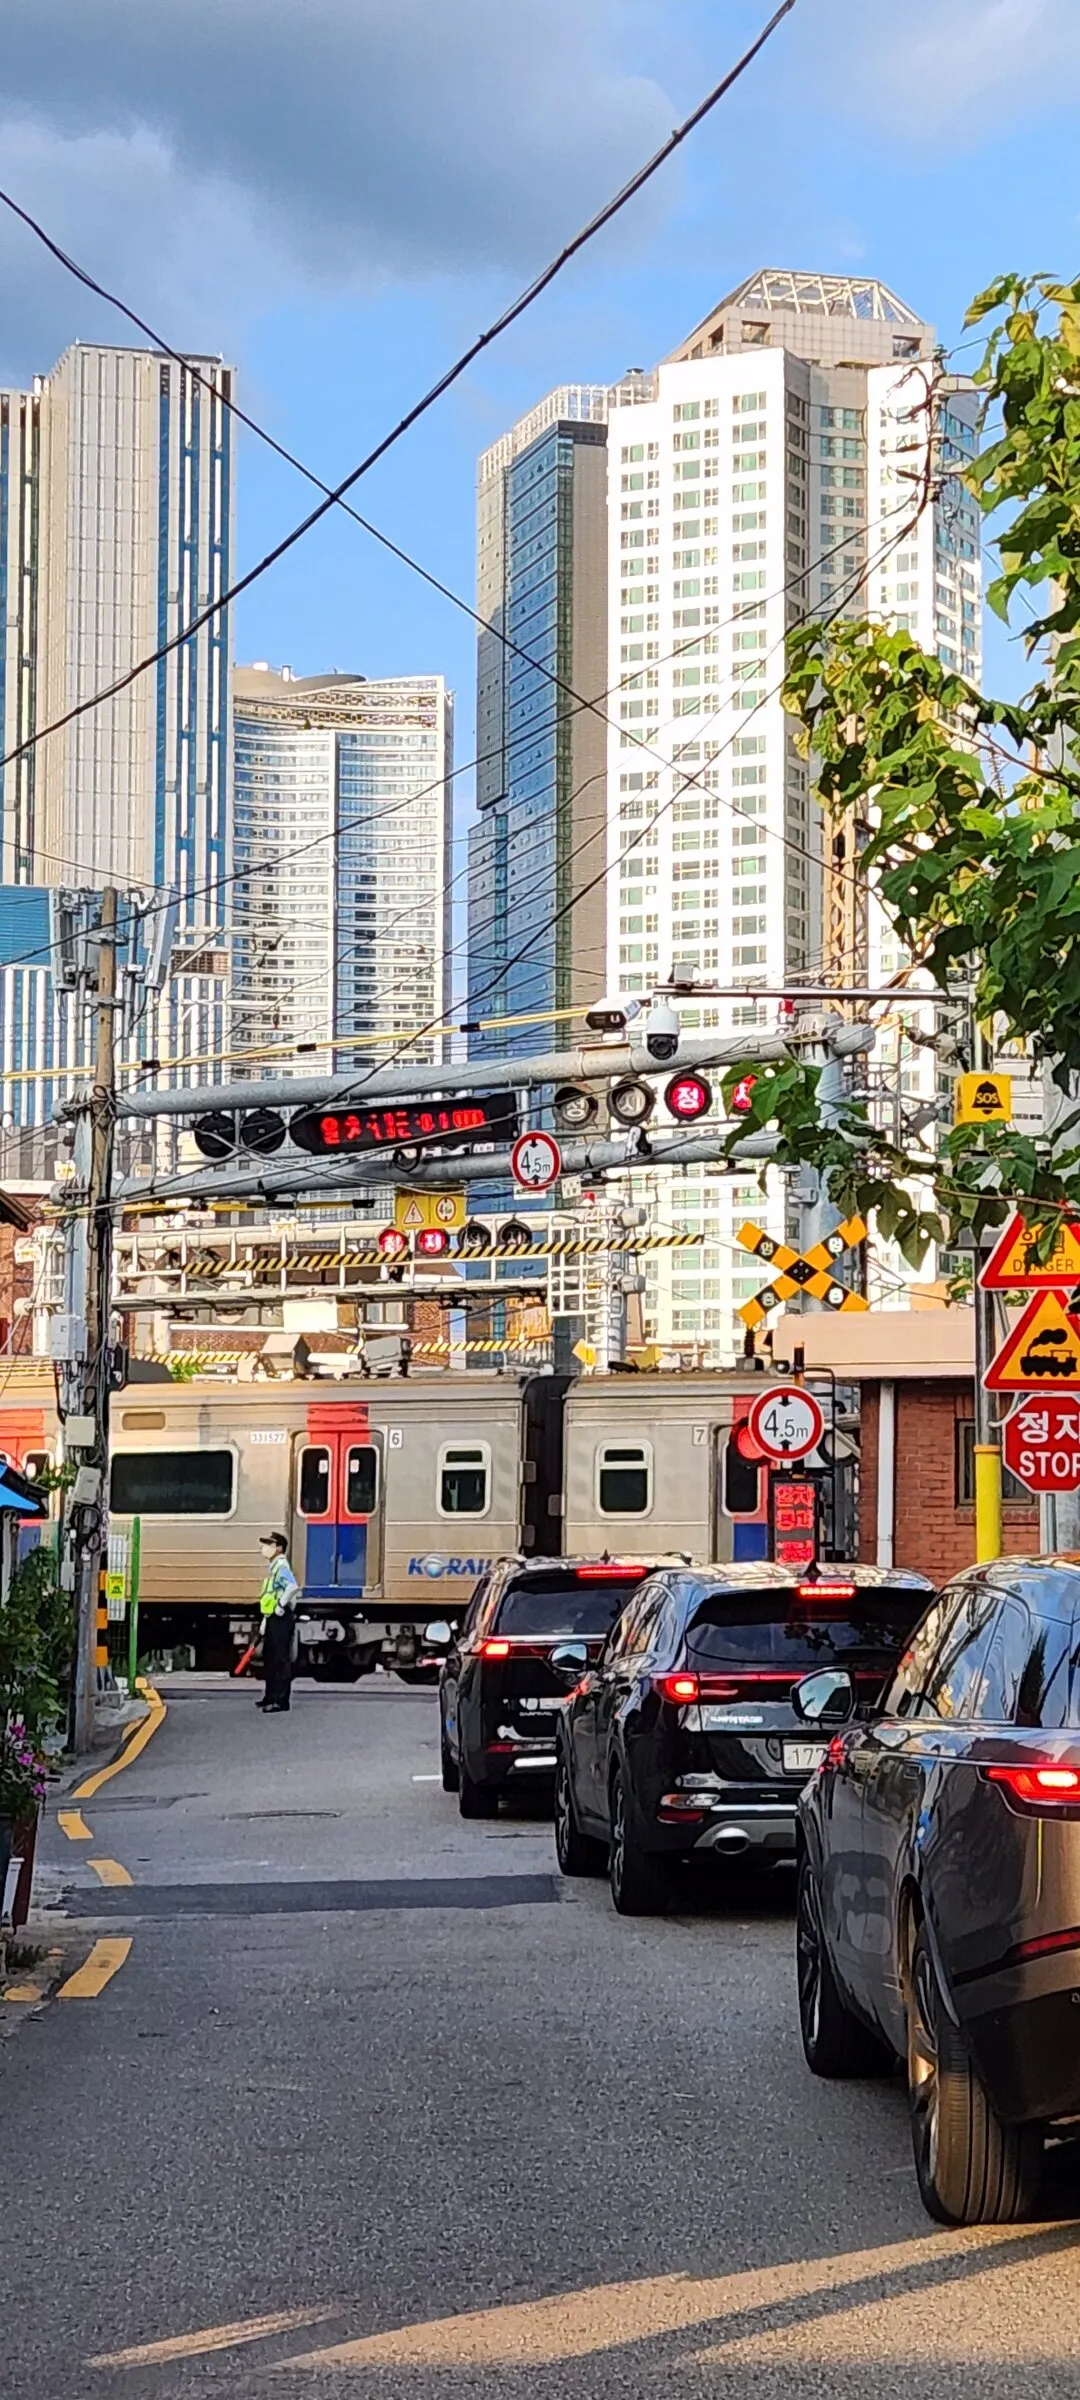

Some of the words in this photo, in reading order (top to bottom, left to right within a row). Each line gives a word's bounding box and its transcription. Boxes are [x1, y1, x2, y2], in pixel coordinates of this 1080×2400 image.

[678, 1086, 700, 1109] 정
[976, 1092, 998, 1104] SOS
[520, 1150, 551, 1174] 4.5m
[1019, 1228, 1066, 1255] 위
[763, 1408, 810, 1438] 4.5m
[391, 1432, 401, 1446] 6
[695, 1428, 706, 1443] 7
